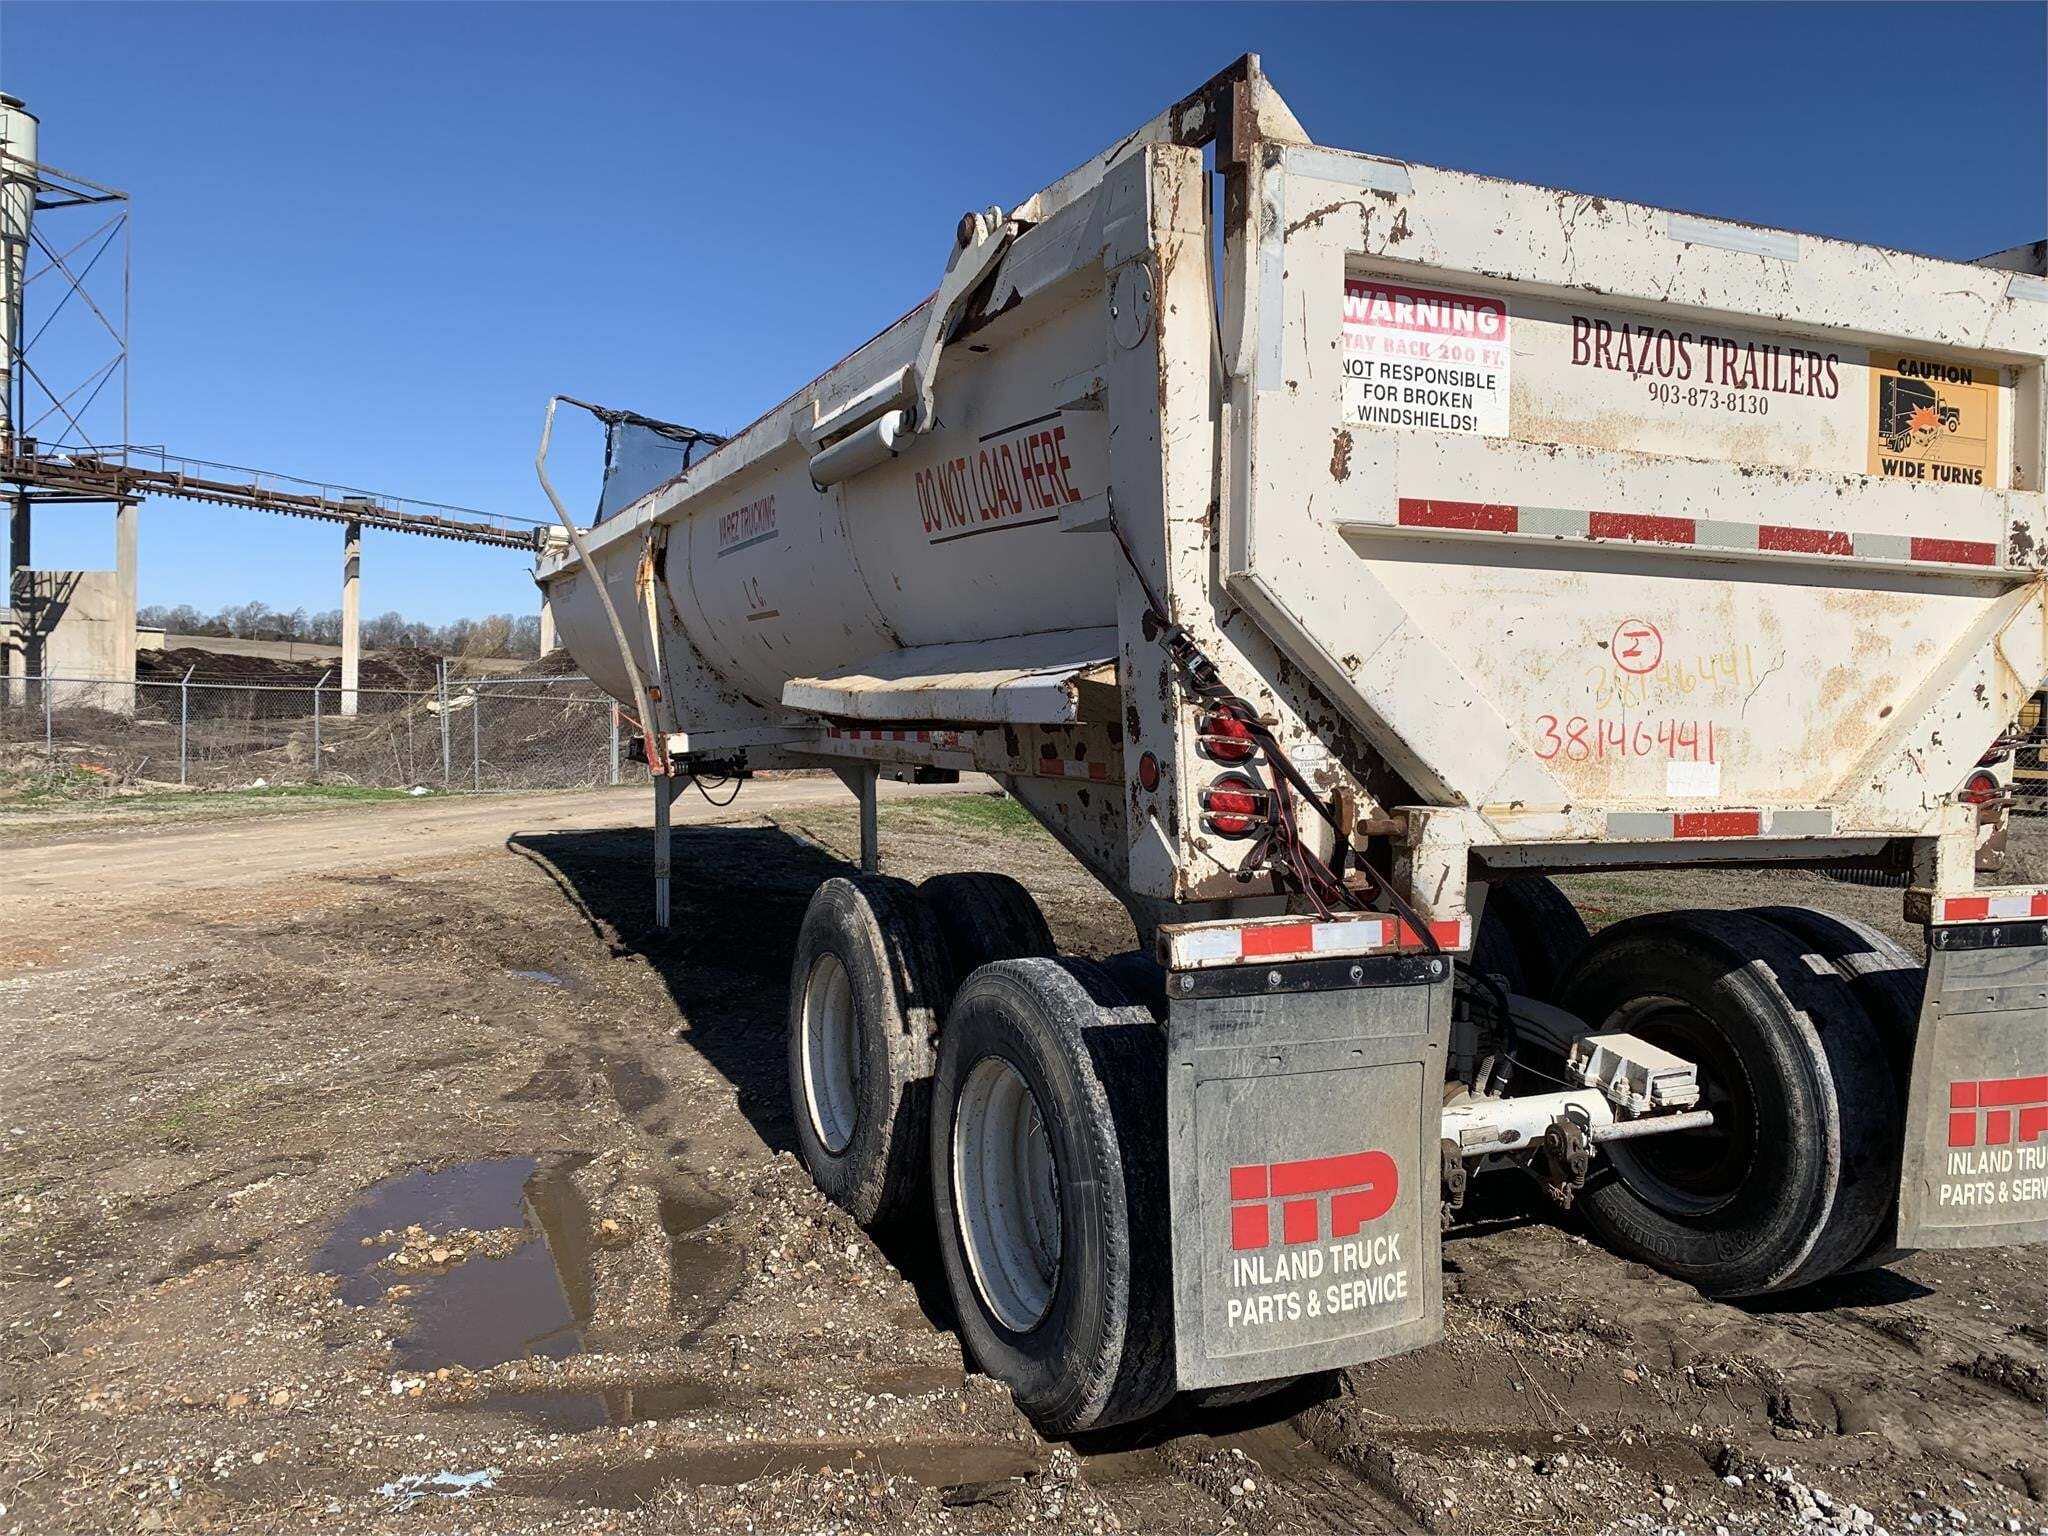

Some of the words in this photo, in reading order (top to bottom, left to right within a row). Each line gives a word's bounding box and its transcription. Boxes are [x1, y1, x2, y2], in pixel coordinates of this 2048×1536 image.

[1344, 288, 1499, 335] WARNING
[1343, 333, 1376, 351] TAY
[1384, 337, 1431, 358] BACK
[1438, 344, 1476, 363] 200
[1571, 315, 1693, 381] BRAZOS
[1700, 332, 1839, 400] TRAILERS
[1380, 362, 1496, 390] RESPONSIBLE
[1897, 358, 1972, 385] CAUTION
[1363, 383, 1398, 402] FOR
[1404, 387, 1473, 410] BROKEN
[1647, 381, 1770, 416] 903-873-8130
[1357, 405, 1477, 431] WINDSHIELDS!
[914, 467, 942, 534] DO
[937, 457, 975, 528] NOT
[969, 443, 1023, 521] LOAD
[1016, 425, 1082, 511] HERE
[1882, 458, 1926, 479] WIDE
[1931, 464, 1984, 485] TURNS
[739, 494, 776, 540] TRUCKING
[1534, 714, 1716, 765] 38146441
[1947, 1150, 2013, 1175] INLAND
[2016, 1146, 2048, 1171] TRU
[1939, 1181, 1995, 1206] PARTS
[1998, 1181, 2009, 1203] &
[1233, 1248, 1324, 1288] INLAND
[1329, 1233, 1401, 1274] TRUCK
[1227, 1291, 1302, 1328] PARTS
[1307, 1289, 1322, 1317] &
[1326, 1270, 1408, 1314] SERVICE
